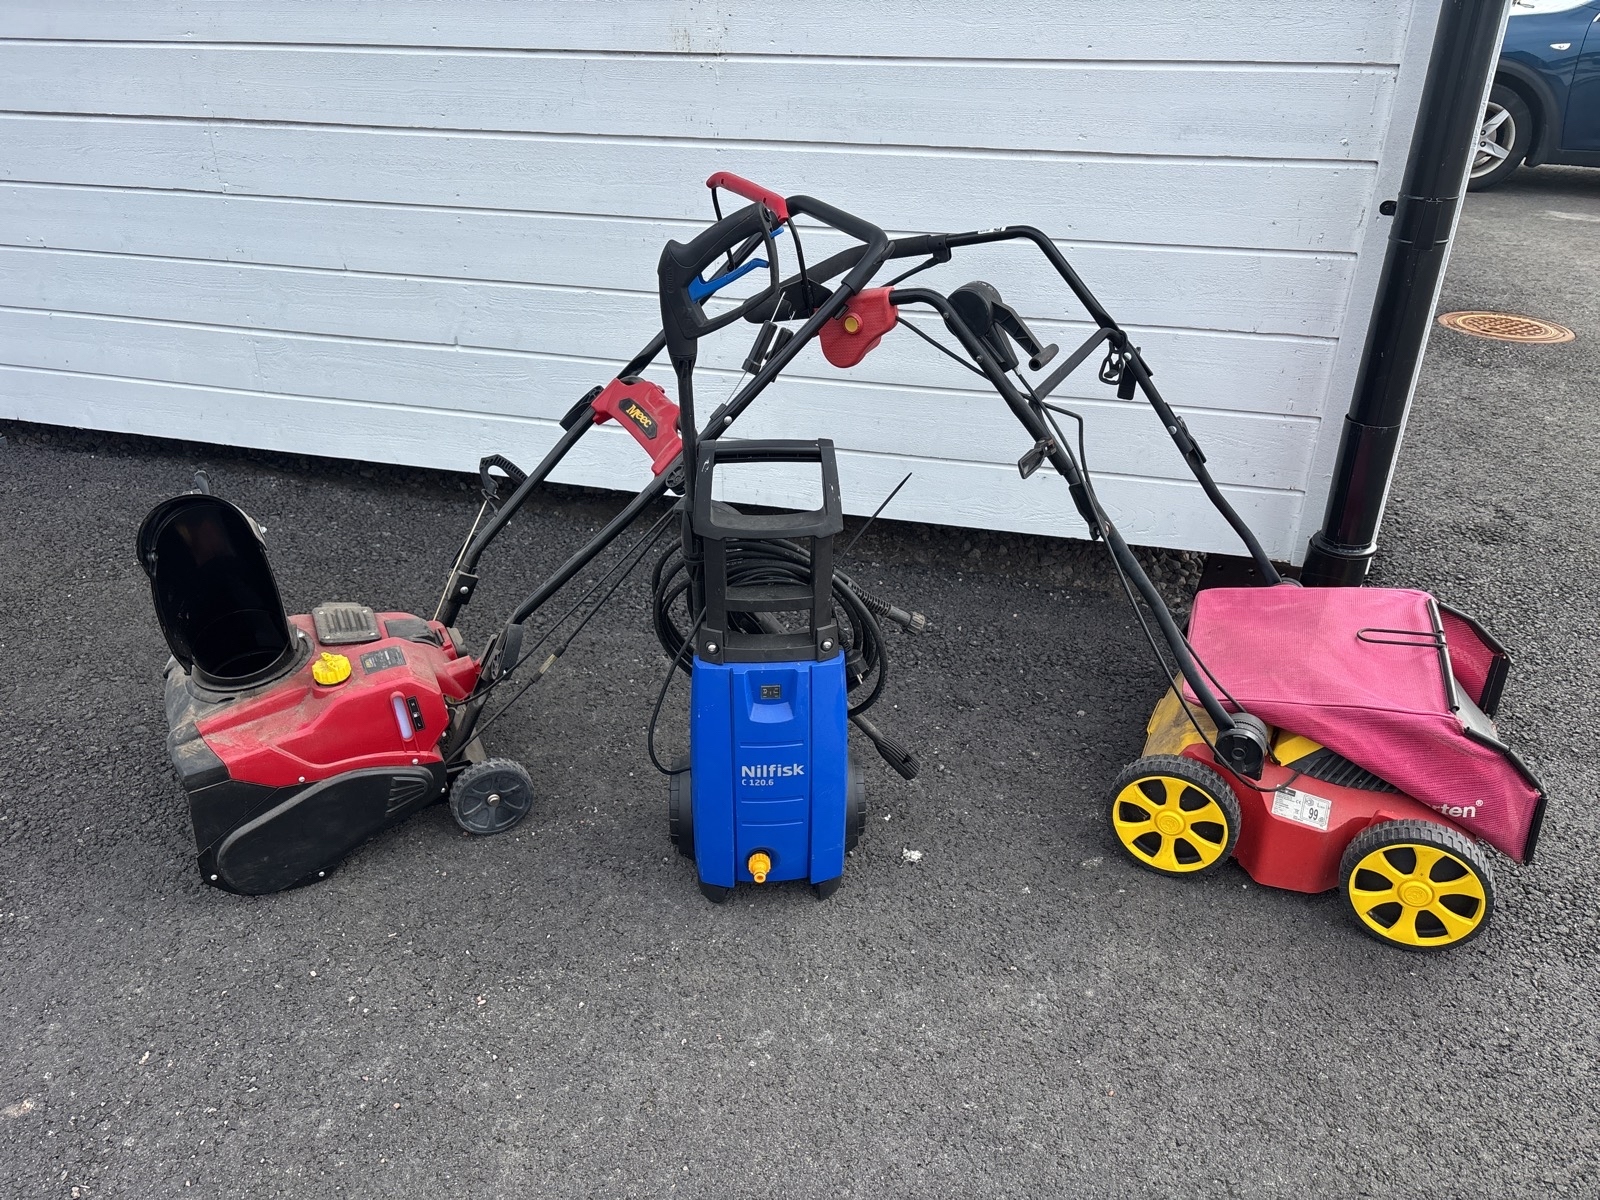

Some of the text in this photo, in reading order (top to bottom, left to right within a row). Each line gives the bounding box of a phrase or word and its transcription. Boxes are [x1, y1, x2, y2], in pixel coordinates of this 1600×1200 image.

[626, 404, 652, 428] Meec
[741, 763, 805, 778] Nilfisk
[1308, 807, 1319, 821] 99
